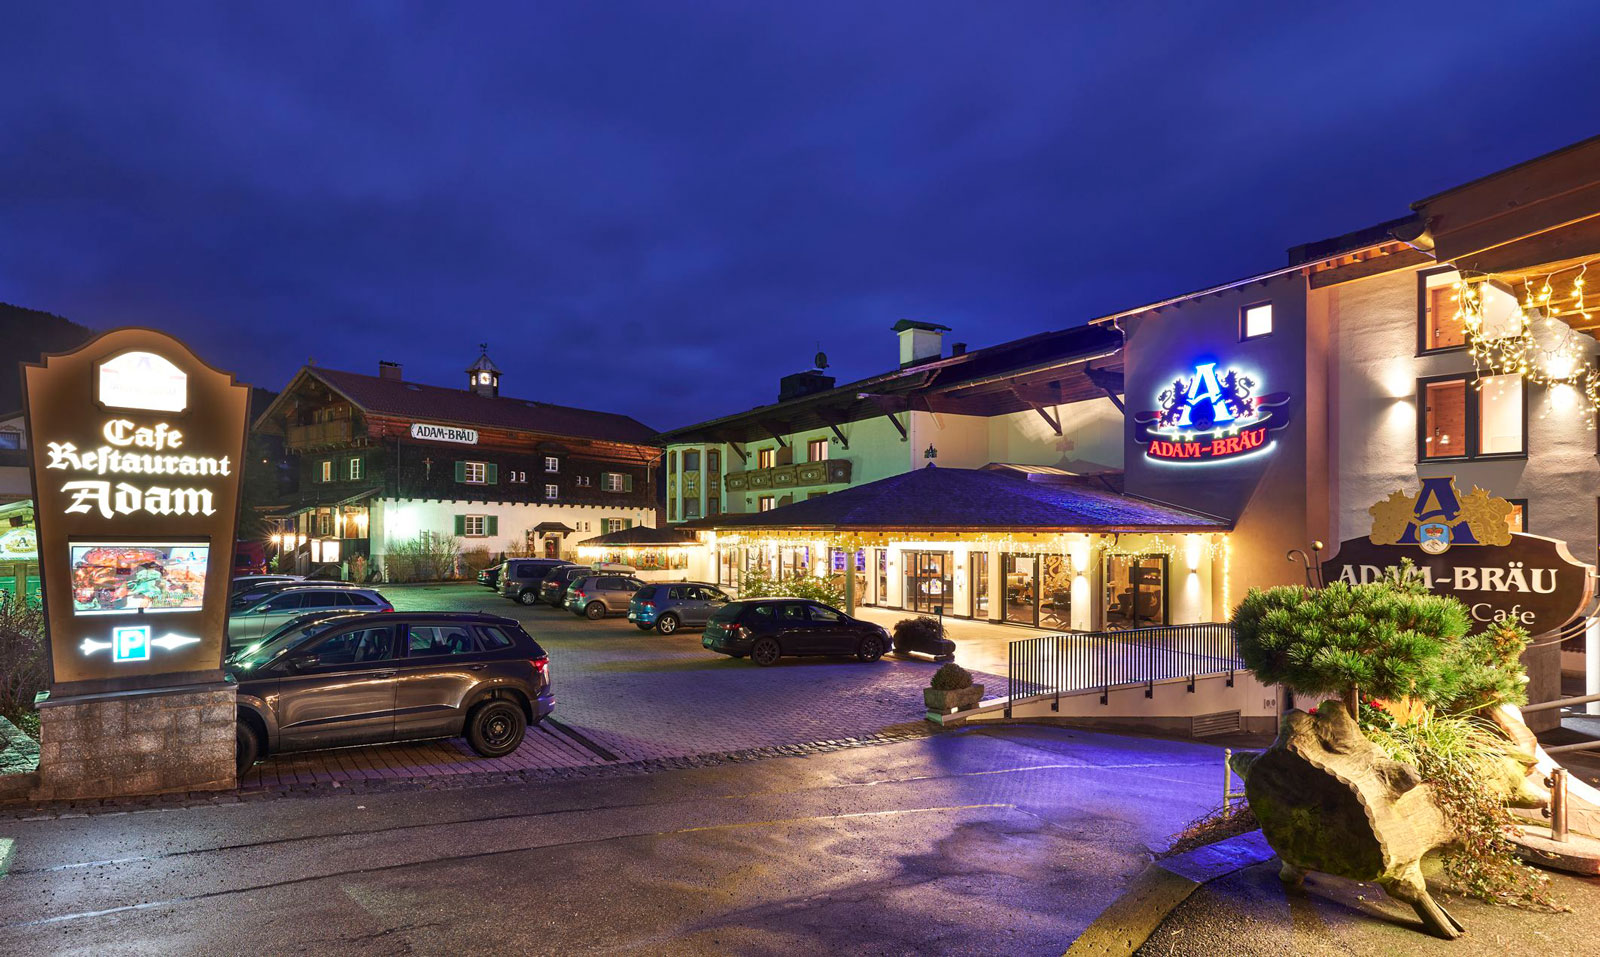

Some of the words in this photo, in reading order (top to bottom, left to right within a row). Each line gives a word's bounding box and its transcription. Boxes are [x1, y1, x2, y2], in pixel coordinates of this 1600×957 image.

[103, 419, 183, 451] Cafe
[416, 426, 474, 442] ADAM-BRÄU
[1150, 428, 1266, 458] ADAM-BRÄU
[60, 480, 217, 519] Adam
[1471, 603, 1536, 625] Cafe
[120, 630, 145, 657] P
